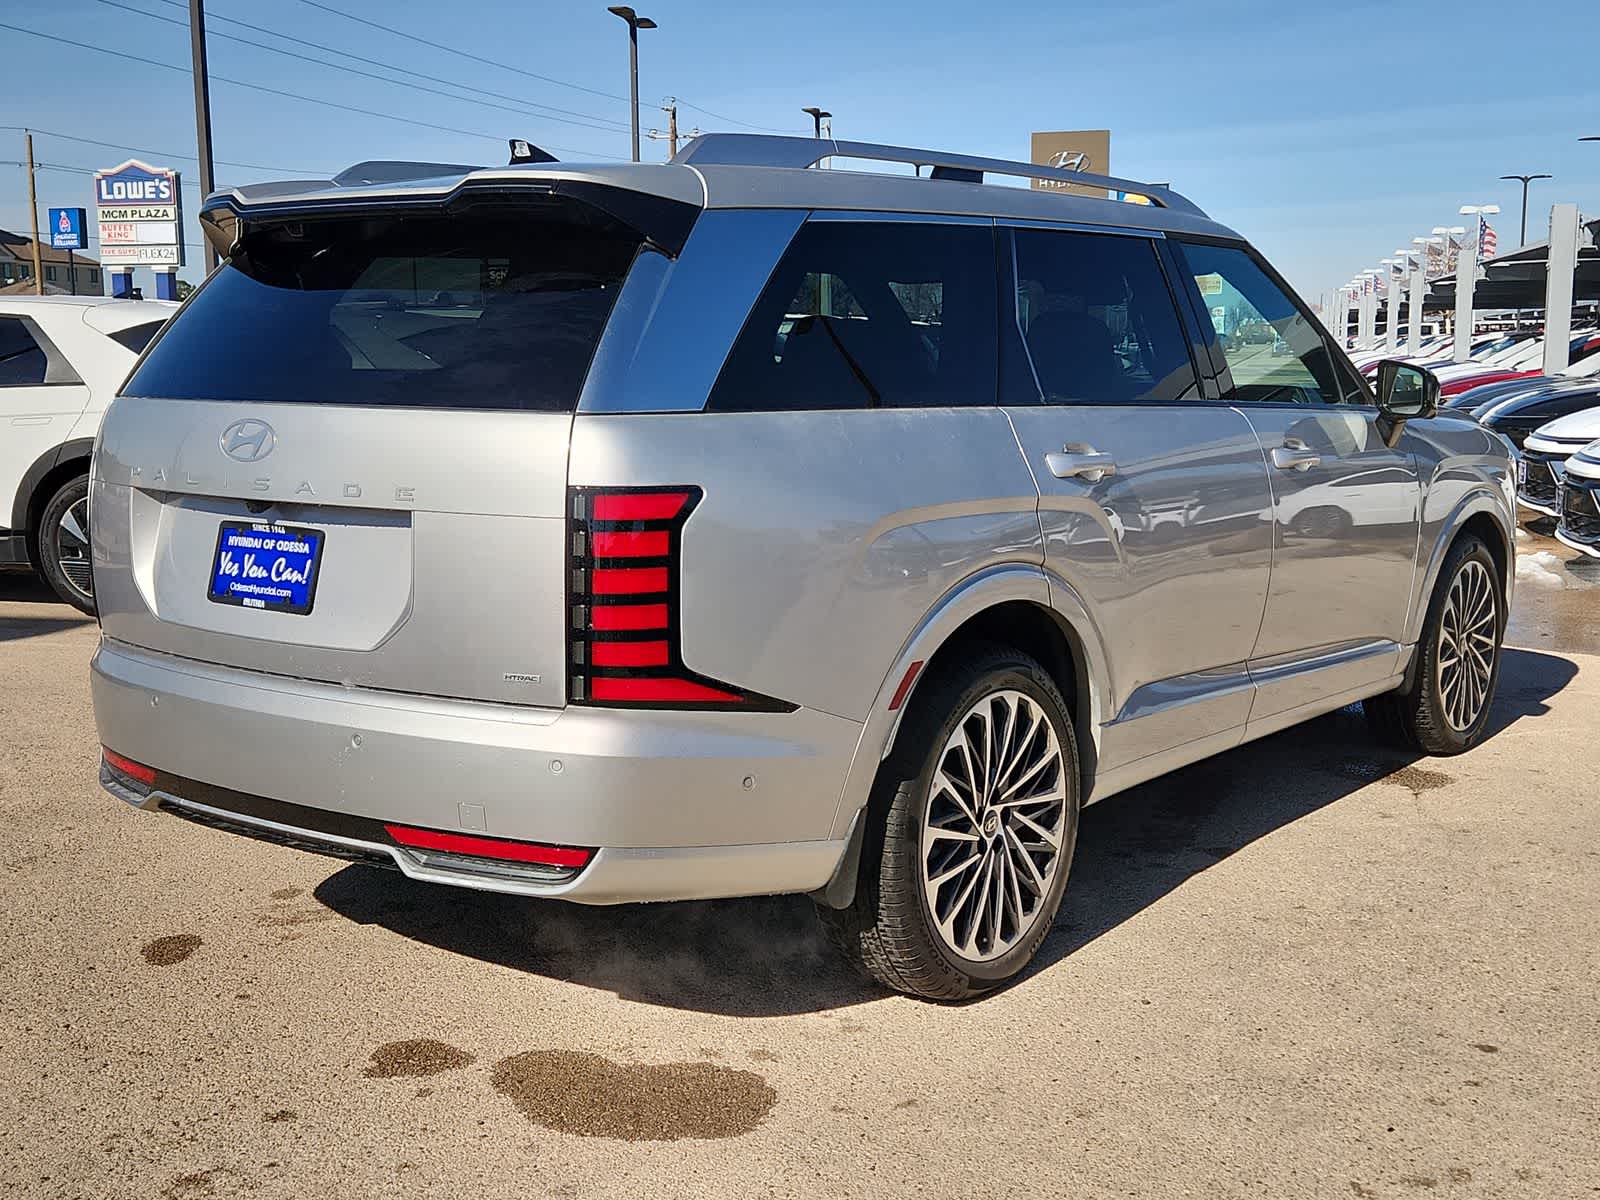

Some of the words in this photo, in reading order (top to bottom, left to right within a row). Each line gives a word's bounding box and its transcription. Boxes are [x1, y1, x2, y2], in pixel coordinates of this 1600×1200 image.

[101, 178, 170, 199] LOWE'S
[102, 209, 128, 219] MCM
[131, 209, 170, 218] PLAZA
[130, 465, 416, 503] PALISADE
[252, 524, 270, 533] SINCE
[228, 536, 262, 549] HYUNDAI
[263, 539, 276, 550] OF
[276, 541, 310, 554] ODESSA
[219, 551, 240, 577] Yes
[242, 553, 268, 578] You
[271, 557, 312, 584] Can!
[229, 582, 292, 597] OdessaHyundai.com
[503, 673, 541, 683] HTRAC
